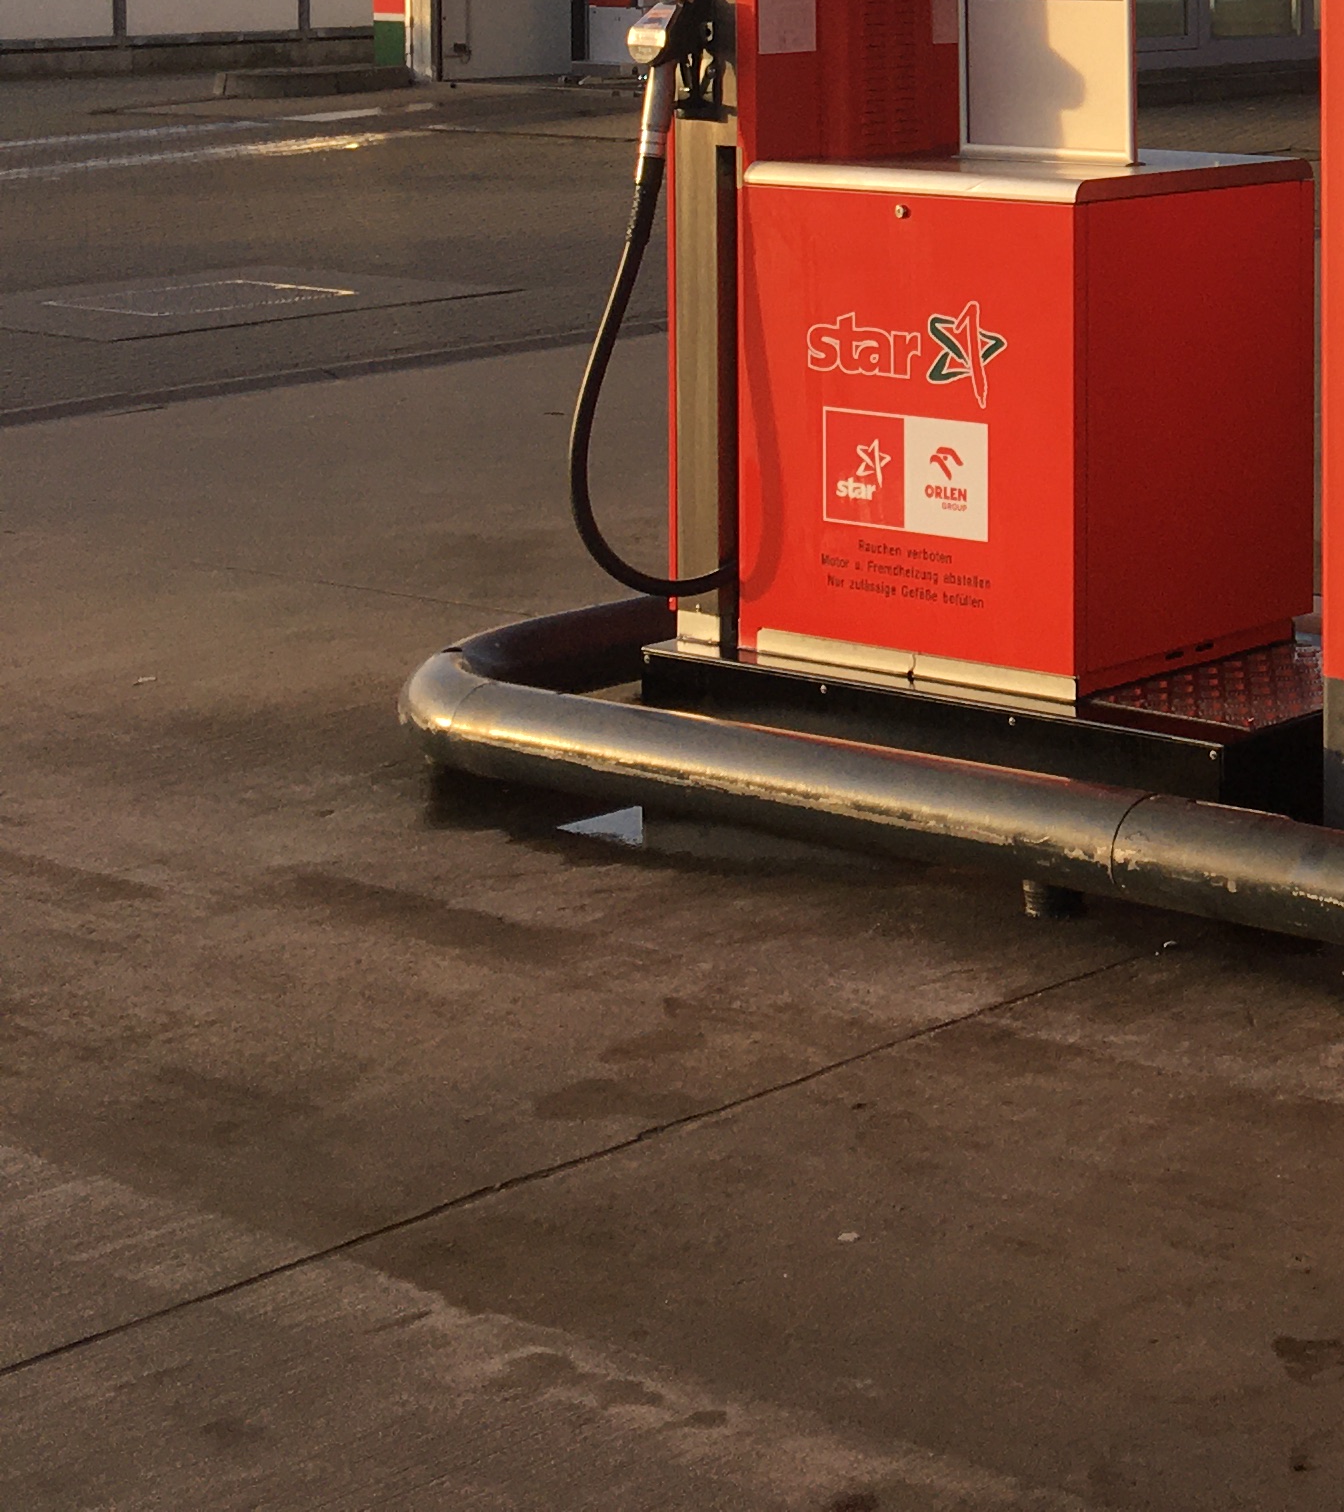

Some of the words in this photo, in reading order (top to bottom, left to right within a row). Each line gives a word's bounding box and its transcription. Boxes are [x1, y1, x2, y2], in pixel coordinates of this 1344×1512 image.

[807, 311, 921, 380] star
[836, 476, 877, 501] star
[924, 484, 968, 502] ORLEN
[941, 501, 968, 512] GROUP
[858, 539, 901, 557] Rauchen
[907, 547, 953, 564] verboten
[821, 553, 849, 568] Motor
[867, 560, 939, 585] Fremdheizung
[943, 572, 991, 589] abstellen
[827, 573, 845, 588] Nur
[850, 575, 896, 598] zulässige
[901, 584, 938, 602] Gefäße
[943, 591, 984, 608] befüllen
